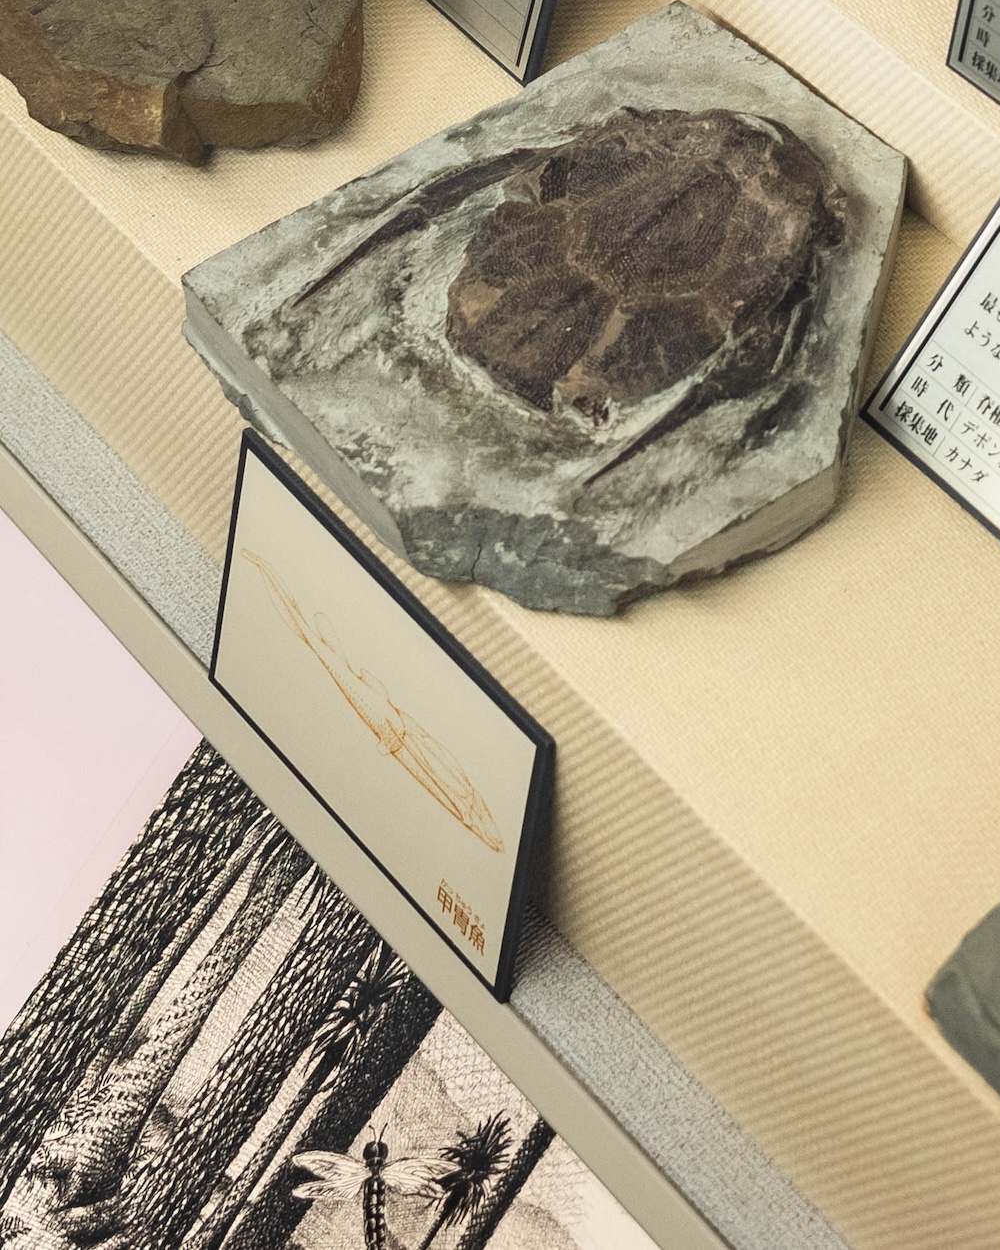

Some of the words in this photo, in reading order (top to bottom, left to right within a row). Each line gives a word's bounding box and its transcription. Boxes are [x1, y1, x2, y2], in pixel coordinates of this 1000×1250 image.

[895, 400, 938, 446] 採集地
[946, 447, 986, 482] カナダ
